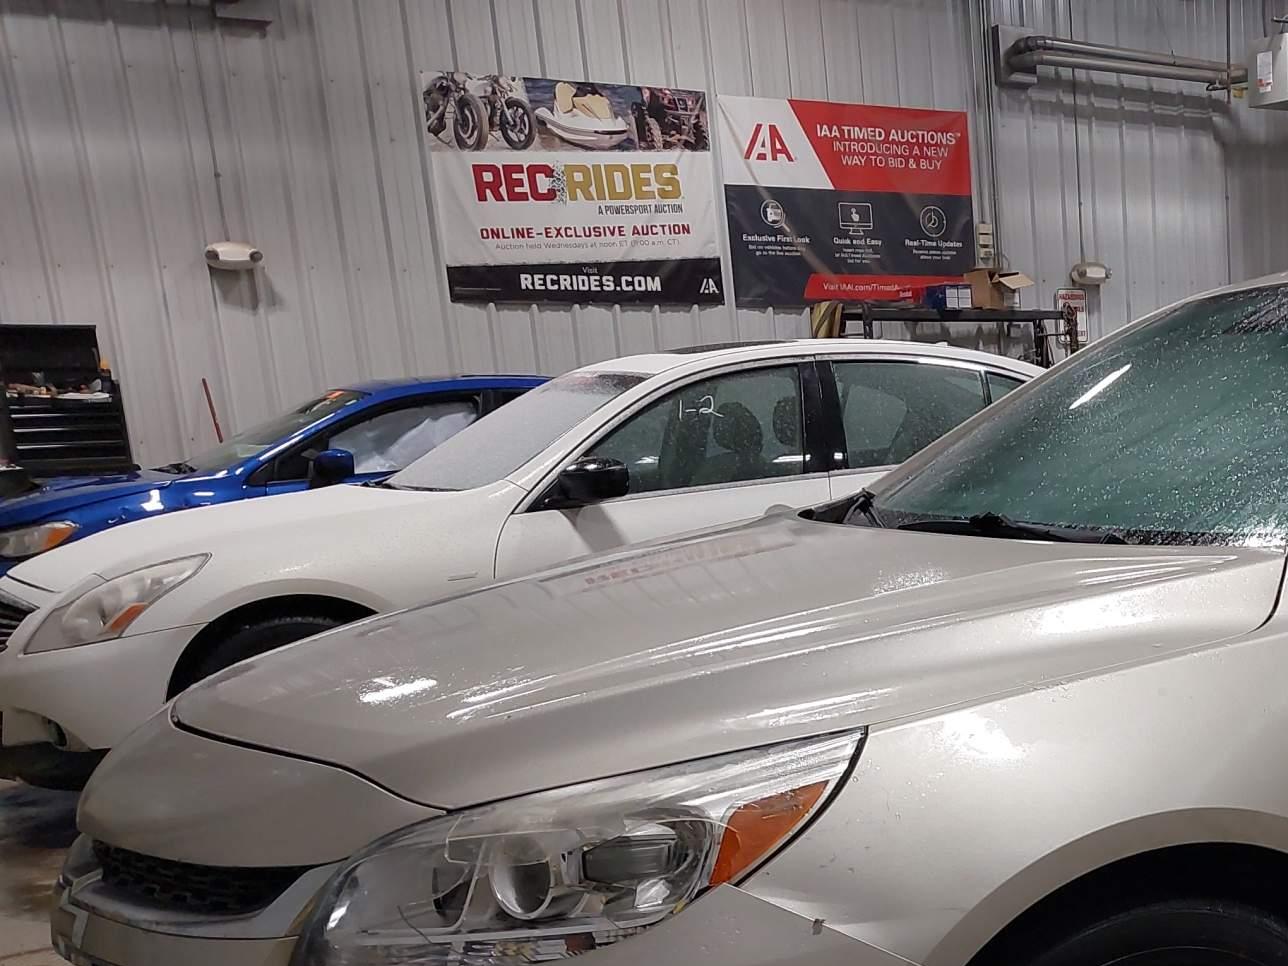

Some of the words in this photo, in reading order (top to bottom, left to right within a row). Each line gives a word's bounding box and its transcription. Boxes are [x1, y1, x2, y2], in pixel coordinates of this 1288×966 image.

[816, 123, 839, 138] IAA
[841, 125, 884, 140] TIMED
[833, 140, 909, 155] INTRODUCING
[912, 145, 921, 156] A
[923, 146, 949, 158] NEW
[841, 155, 866, 167] WAY
[869, 156, 885, 167] TO
[888, 157, 905, 169] BID
[908, 158, 917, 169] &
[920, 159, 942, 170] BUY
[598, 205, 604, 215] A
[605, 204, 652, 215] POWERSPORT
[654, 203, 683, 214] AUCTION
[480, 225, 626, 240] ONLINE-EXCLUSIVE
[631, 223, 691, 237] AUCTION
[742, 233, 776, 242] Exclusive
[776, 234, 793, 243] First
[833, 237, 851, 245] Quick
[866, 238, 882, 247] Easy
[905, 238, 937, 247] Real-Time
[938, 240, 963, 248] Updates
[495, 242, 525, 250] Auction
[526, 242, 542, 250] held
[543, 241, 588, 251] Wednesdays
[590, 241, 597, 249] at
[599, 240, 618, 248] noon
[582, 266, 598, 274] Visit
[520, 274, 662, 292] RECRIDES.COM
[823, 281, 839, 291] Visit
